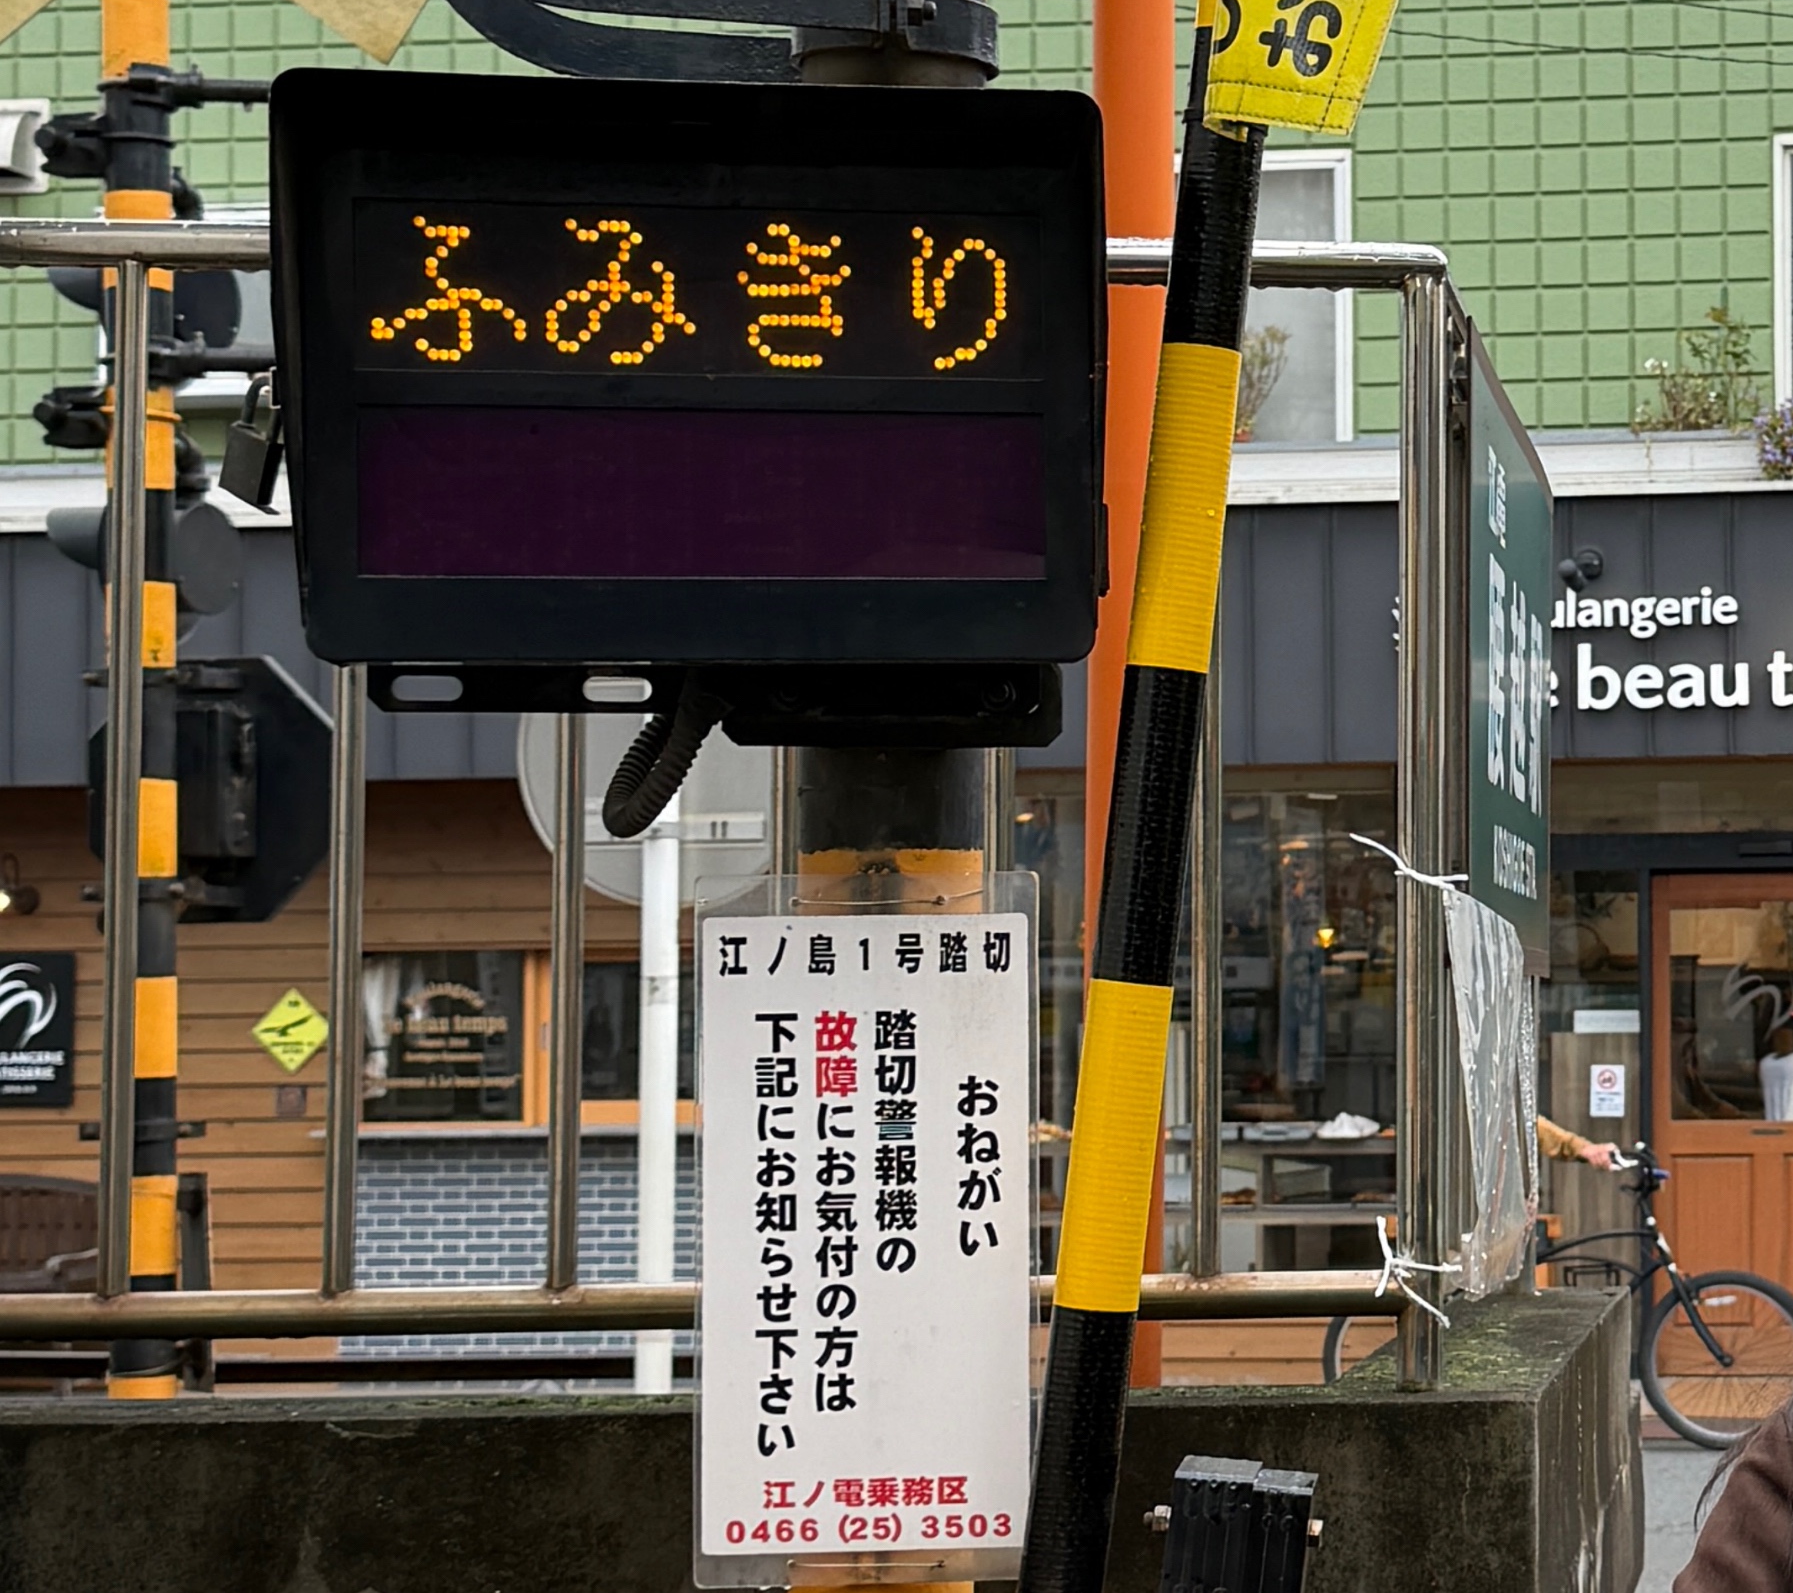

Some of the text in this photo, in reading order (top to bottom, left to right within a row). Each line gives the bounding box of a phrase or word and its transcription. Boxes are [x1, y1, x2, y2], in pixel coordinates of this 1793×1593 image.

[1577, 643, 1750, 710] beau
[719, 931, 1011, 976] 江ノ島1号踏切
[874, 1009, 918, 1273] 踏切警報機の
[957, 1075, 1002, 1256] おねがい
[755, 1013, 799, 1457] 下記にお知らせ下さい
[815, 1010, 858, 1412] 故障にお気付の方は
[725, 1512, 1012, 1544] 0466 (25) 3503
[763, 1476, 969, 1509] 江ノ電乗務区
